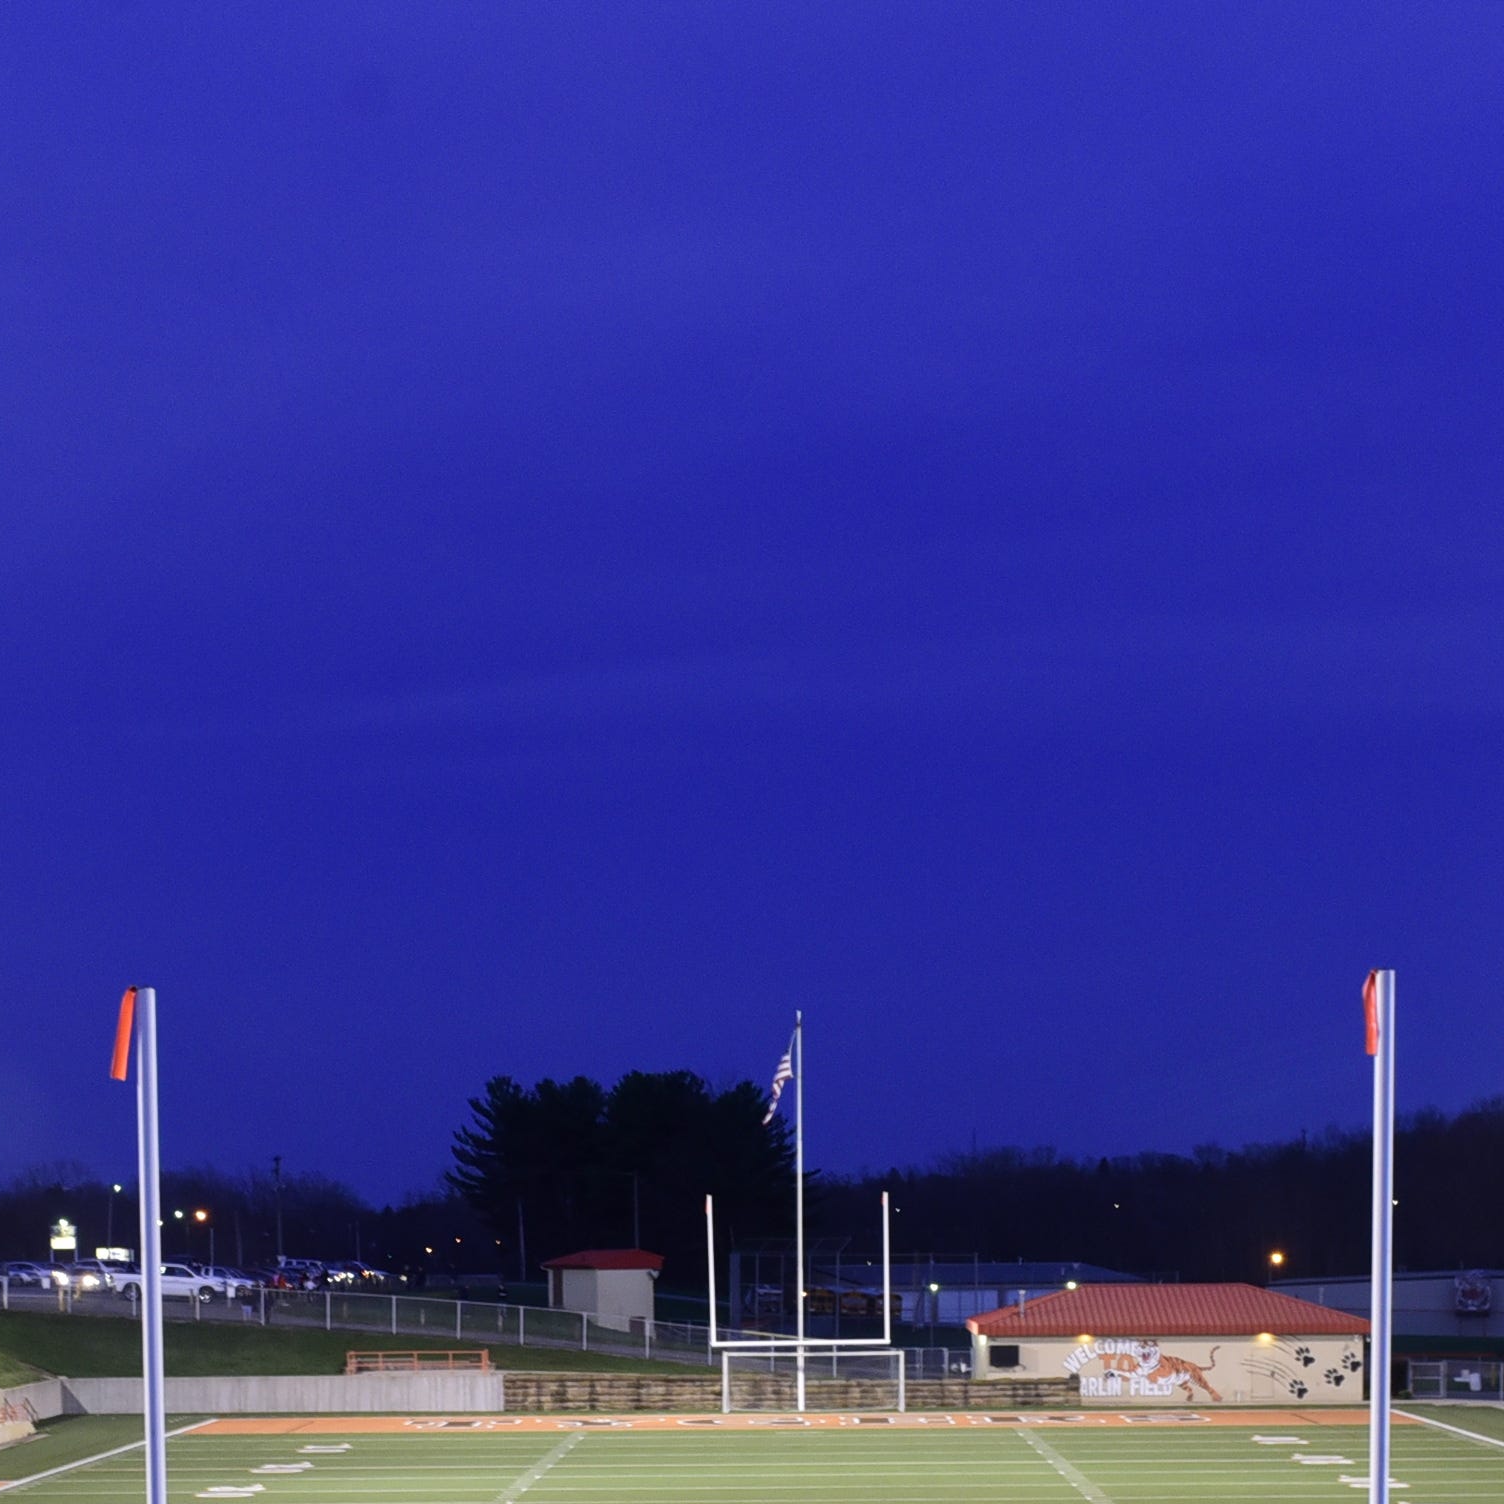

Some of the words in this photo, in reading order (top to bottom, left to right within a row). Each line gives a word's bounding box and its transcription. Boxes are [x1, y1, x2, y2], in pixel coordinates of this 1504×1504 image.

[1062, 1339, 1141, 1374] WELCOME
[1098, 1353, 1137, 1373] TO
[1129, 1375, 1174, 1397] FIELD
